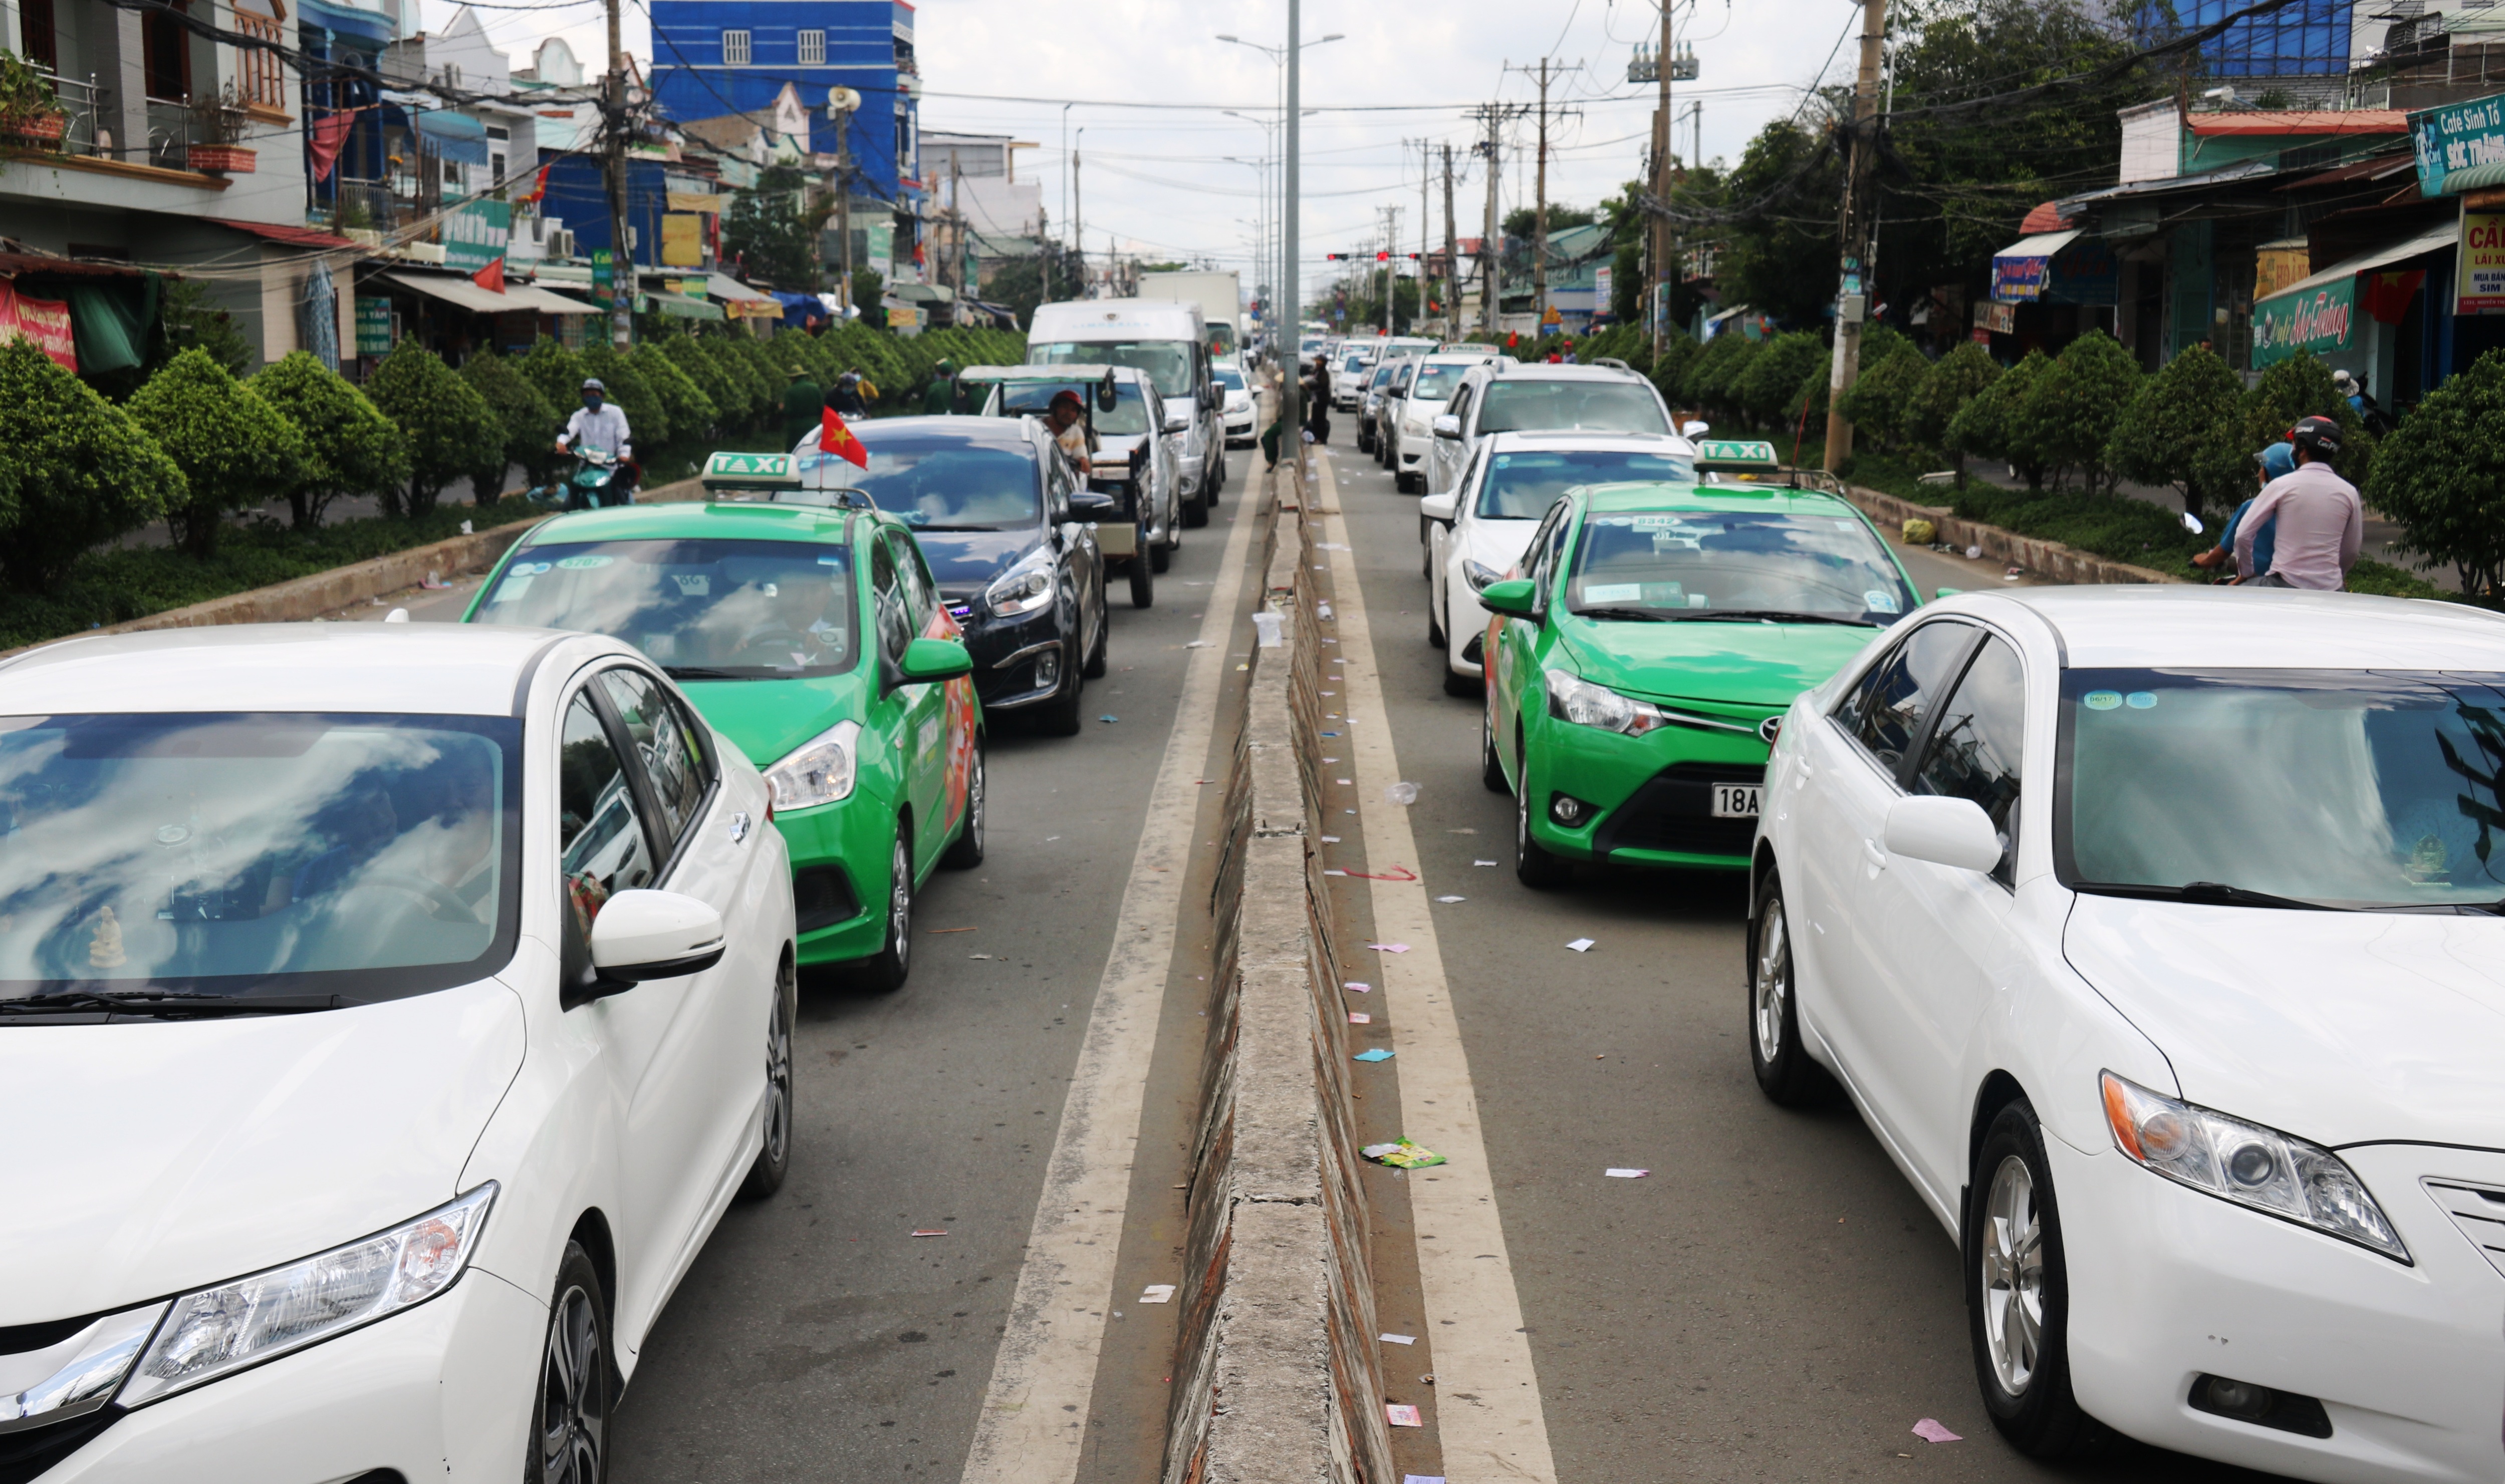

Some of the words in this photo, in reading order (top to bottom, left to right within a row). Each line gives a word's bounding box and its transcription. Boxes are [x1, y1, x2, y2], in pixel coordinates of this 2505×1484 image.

[2440, 110, 2463, 135] Café
[2463, 106, 2486, 131] Sinh
[2486, 100, 2499, 126] Tố
[2475, 253, 2491, 265] LÃI
[2474, 273, 2488, 282] MUA
[2479, 283, 2500, 292] SIM
[1721, 788, 1759, 813] 18A
